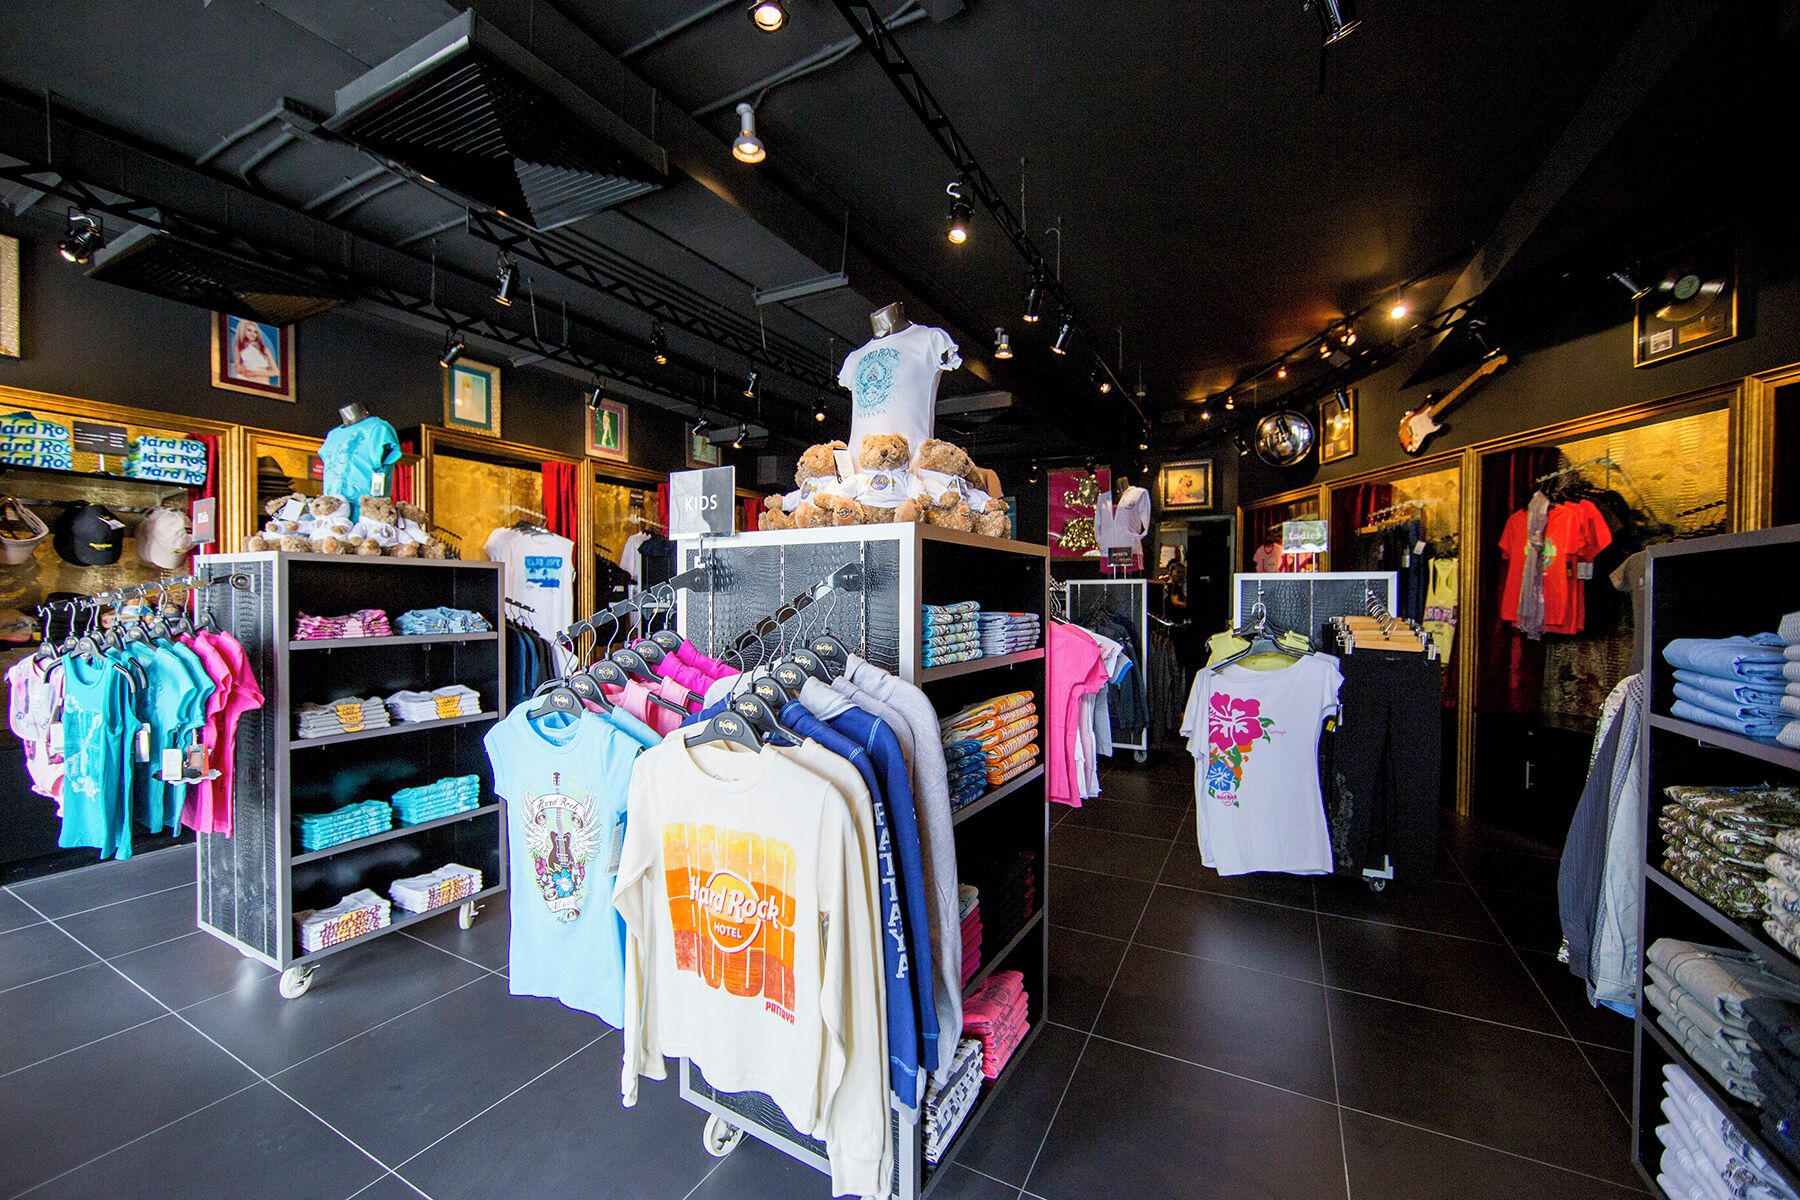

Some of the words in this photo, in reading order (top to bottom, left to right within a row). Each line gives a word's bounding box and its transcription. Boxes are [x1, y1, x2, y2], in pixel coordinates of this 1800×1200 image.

[0, 419, 37, 434] ard
[40, 422, 67, 437] Ro
[0, 440, 35, 452] ard
[0, 455, 35, 467] ard
[685, 494, 718, 511] KIDS
[873, 802, 909, 979] PATTAYA
[689, 876, 727, 913] Hard
[727, 889, 779, 930] Rock
[713, 921, 743, 940] HOTEL
[765, 1001, 796, 1026] PATTAYA
